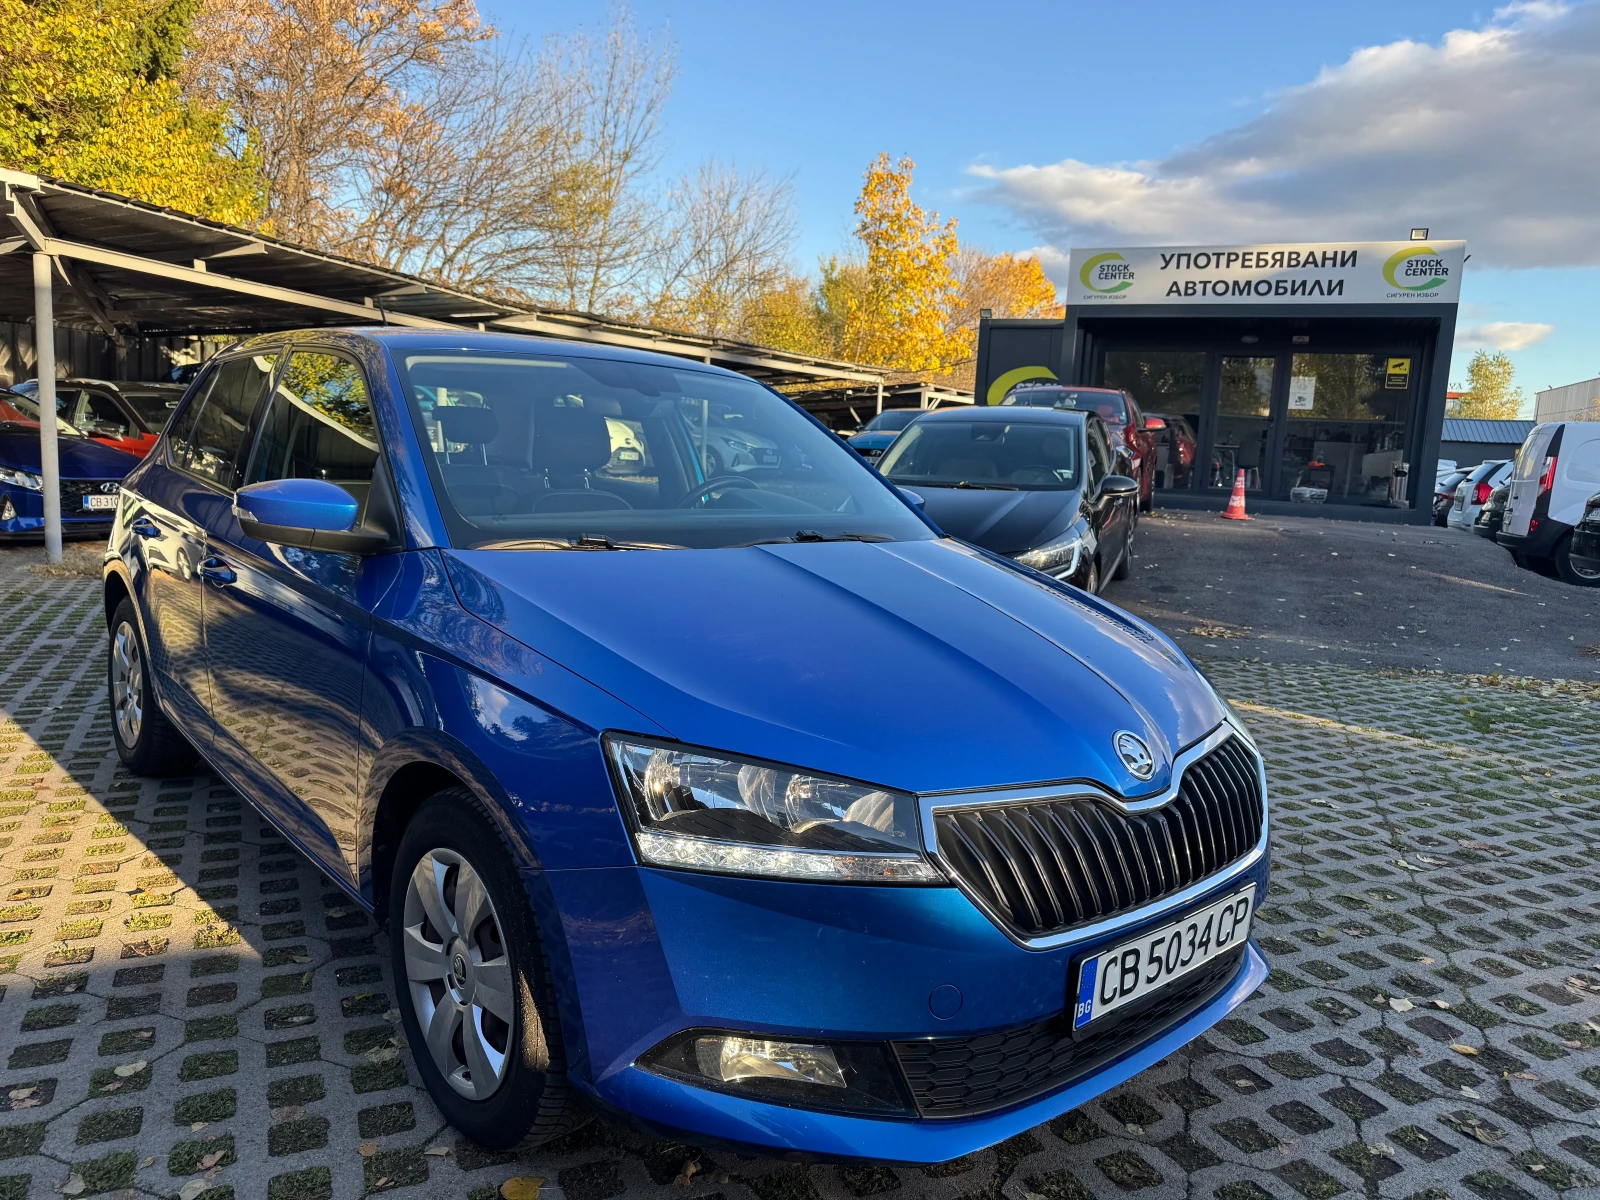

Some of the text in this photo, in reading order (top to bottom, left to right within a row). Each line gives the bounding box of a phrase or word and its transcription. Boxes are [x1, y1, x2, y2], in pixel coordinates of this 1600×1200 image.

[1160, 250, 1358, 270] УПОТРЕБЯВАНИ
[1406, 259, 1443, 268] STOCK
[1099, 264, 1130, 272] STOCK
[1405, 267, 1449, 276] CENTER
[1098, 272, 1135, 280] CENTER
[1165, 279, 1344, 297] АВТОМОБИЛИ
[1077, 999, 1092, 1018] BG
